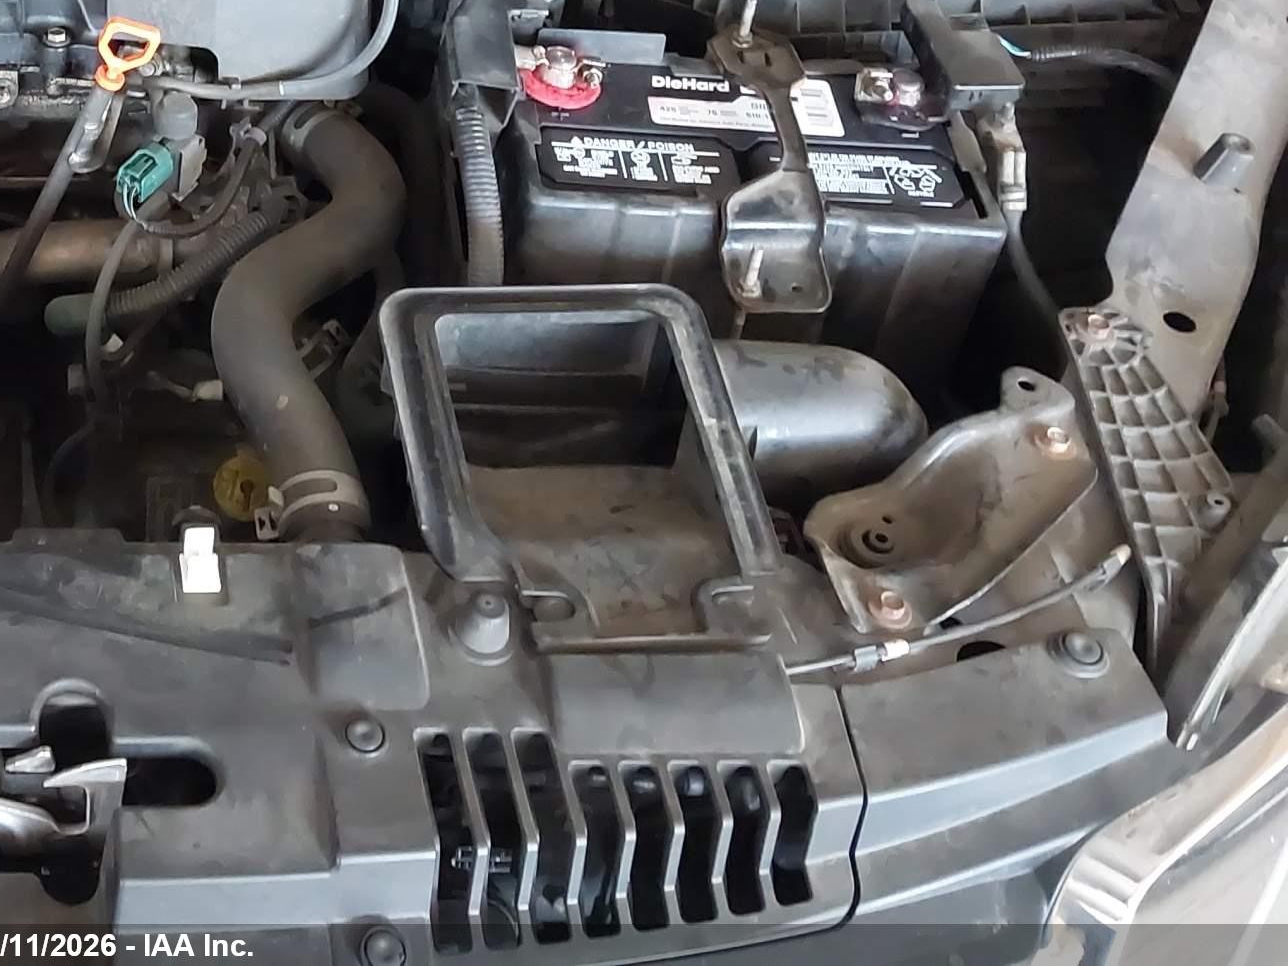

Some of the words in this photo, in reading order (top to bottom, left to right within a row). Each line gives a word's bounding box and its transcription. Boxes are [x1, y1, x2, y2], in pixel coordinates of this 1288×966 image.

[651, 75, 730, 93] DieHard
[583, 136, 635, 150] DANGER
[647, 141, 695, 153] POISON
